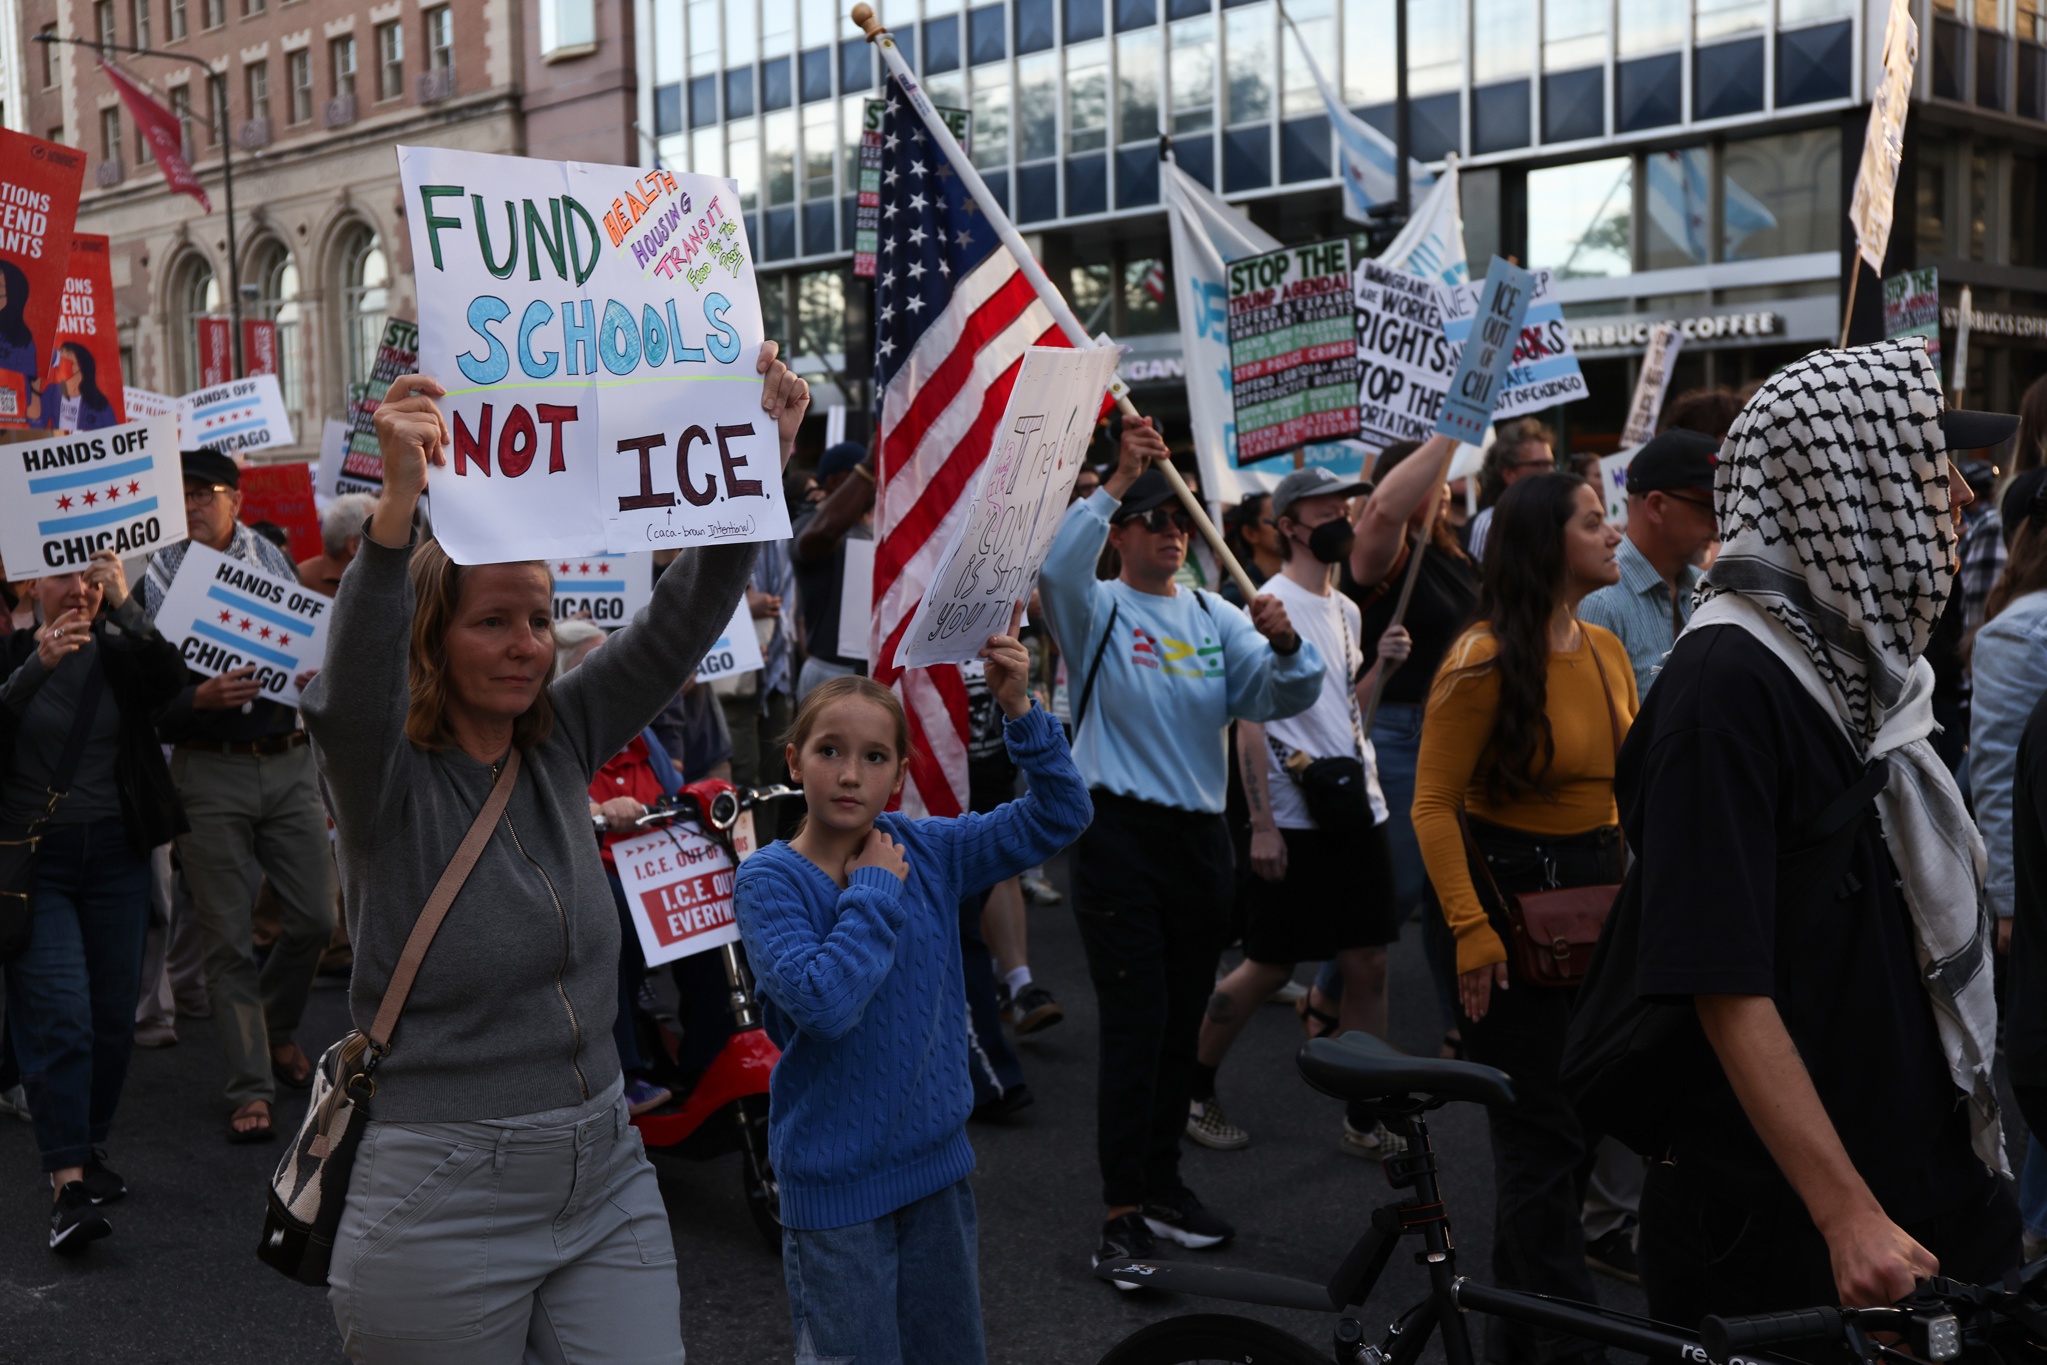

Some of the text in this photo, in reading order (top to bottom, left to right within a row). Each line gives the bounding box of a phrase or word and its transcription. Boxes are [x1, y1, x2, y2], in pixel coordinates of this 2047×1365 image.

[603, 169, 678, 248] HEALTH
[419, 185, 601, 287] FUND
[631, 192, 691, 270] HOUSING
[654, 195, 724, 280] TRANSIT
[1230, 244, 1345, 296] STOP THE
[1364, 263, 1430, 298] IMMIGRANT
[1231, 288, 1276, 316] TRUMP
[1231, 306, 1278, 329] DEFEND
[1297, 291, 1354, 312] EXPAND
[1304, 303, 1354, 321] RIGHTS
[1359, 287, 1380, 304] ARE
[1437, 286, 1470, 320] WE
[1490, 280, 1521, 321] ICE
[456, 292, 741, 385] SCHOOLS
[1482, 316, 1511, 348] OUT
[1682, 311, 1775, 339] COFFEE
[1942, 306, 2015, 336] STRBUCKS
[379, 345, 417, 367] TRUMP
[1234, 363, 1262, 381] STOP
[1309, 343, 1355, 359] CRIMES
[1480, 349, 1497, 369] OF
[233, 382, 257, 396] OFF
[1235, 375, 1275, 397] DEFEND
[1331, 357, 1357, 371] AND
[1313, 371, 1357, 387] RIGHTS
[1357, 358, 1404, 405] TOP
[1407, 381, 1446, 421] THE
[1461, 370, 1493, 403] CHI
[1501, 365, 1537, 391] AFE
[453, 402, 578, 478] NOT
[1305, 420, 1359, 436] REEDOM
[22, 428, 149, 473] HANDS OFF
[616, 422, 770, 512] I.C.E.
[42, 517, 161, 568] CHICAGO
[215, 562, 325, 619] HANDS OFF
[634, 857, 673, 880] I.C.E.
[676, 847, 703, 868] OUT
[706, 844, 720, 860] OF
[660, 879, 712, 911] I.C.E.
[667, 899, 736, 938] EVERYW
